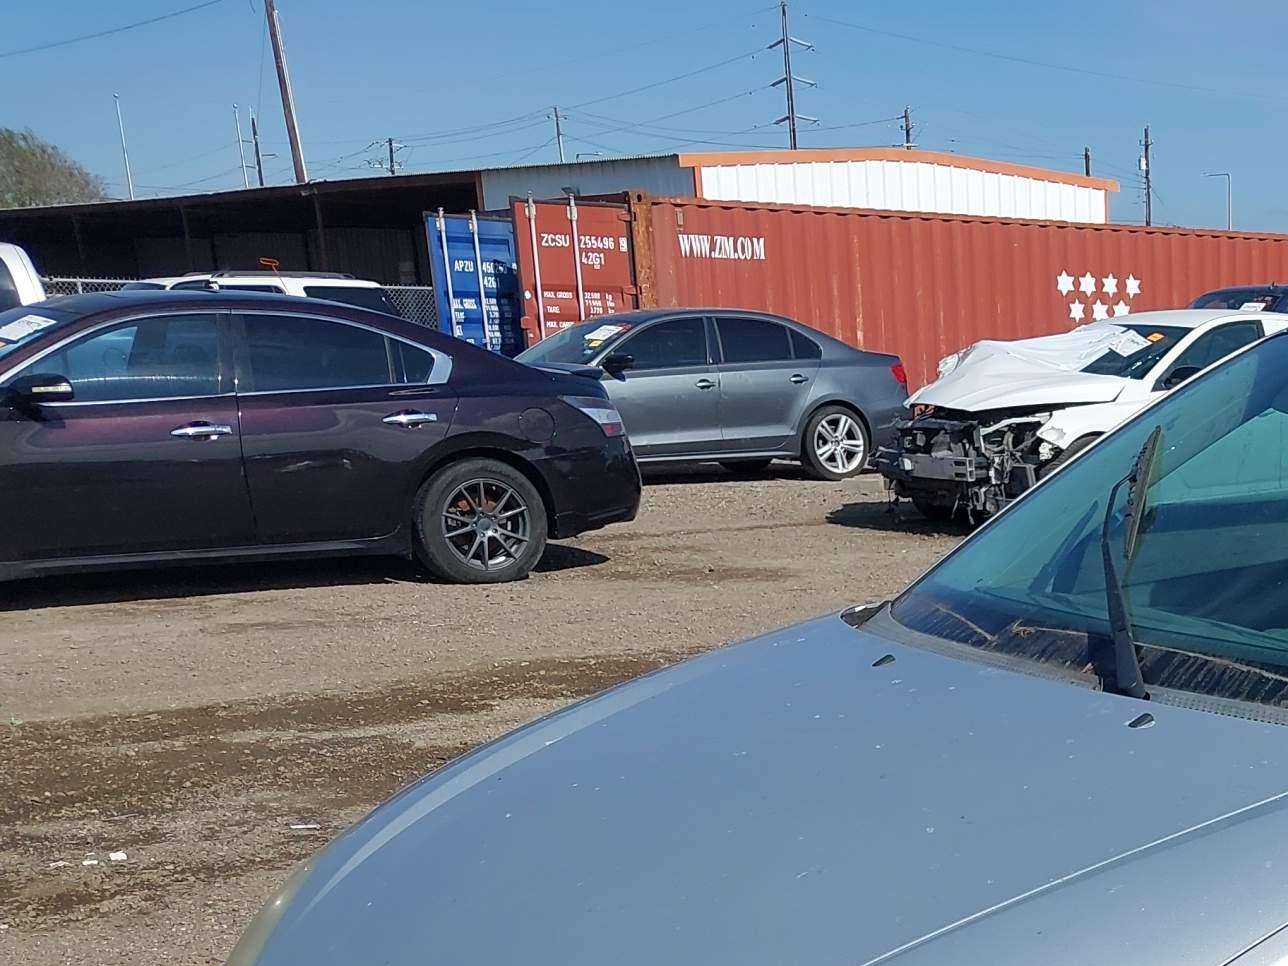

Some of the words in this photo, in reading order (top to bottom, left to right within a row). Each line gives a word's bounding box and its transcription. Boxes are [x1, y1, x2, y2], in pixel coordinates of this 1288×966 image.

[541, 234, 570, 248] ZCSU
[579, 236, 615, 250] 255496
[581, 253, 605, 265] 42G1
[454, 260, 474, 273] APZU
